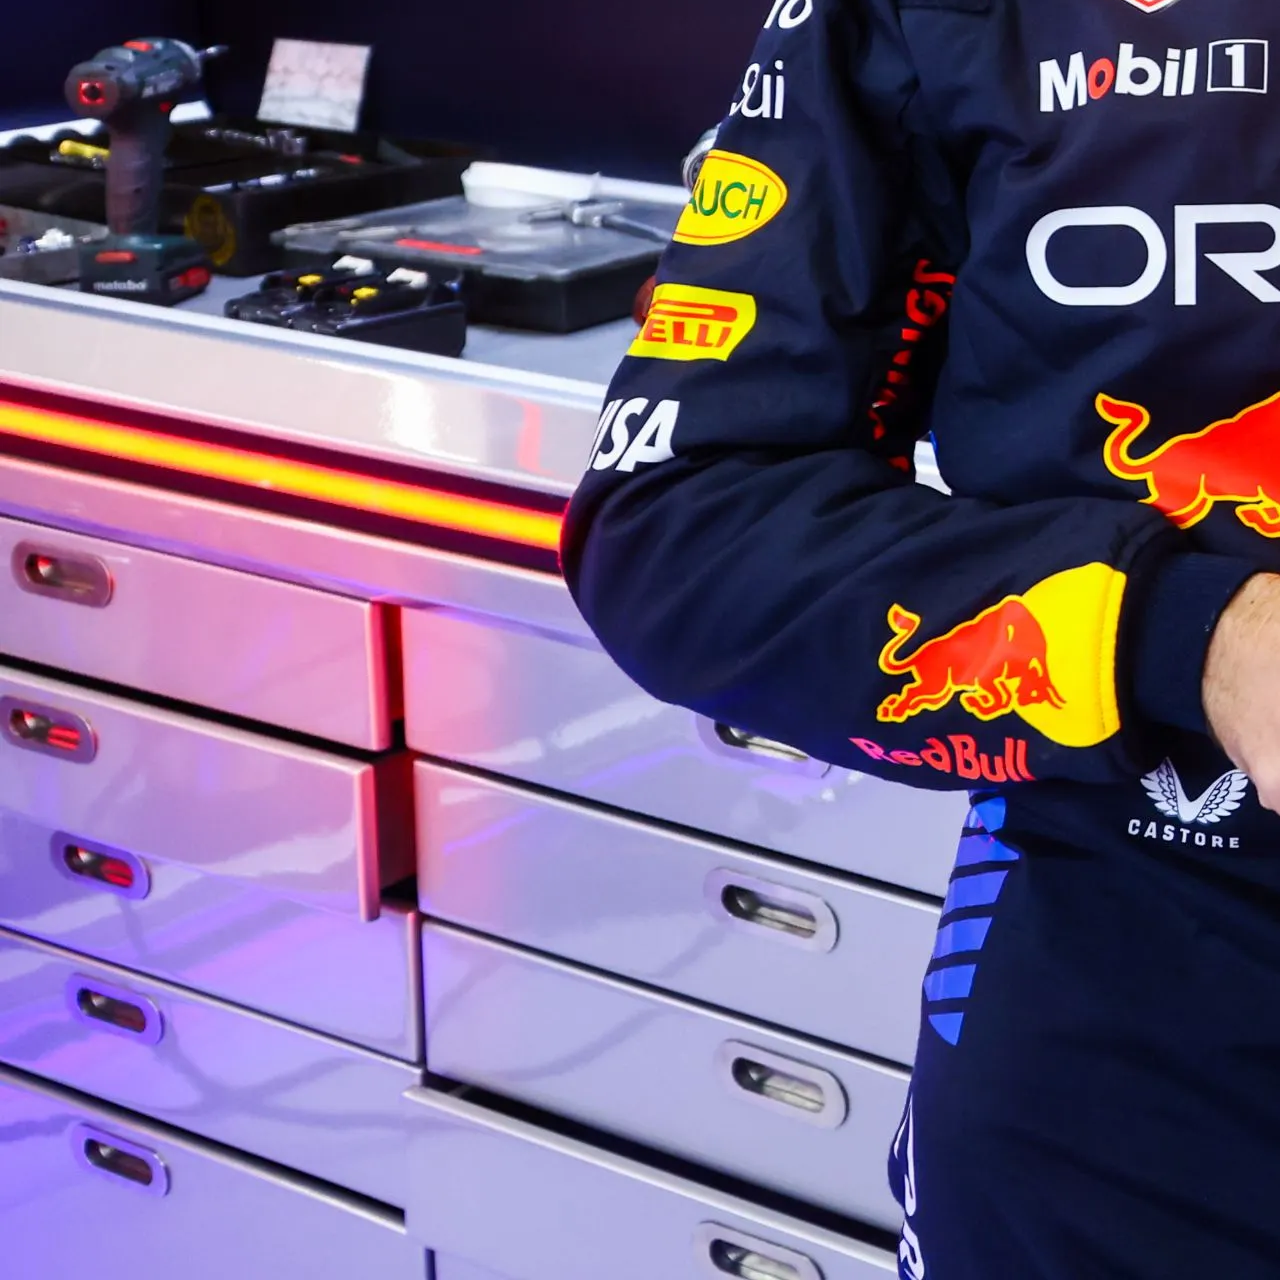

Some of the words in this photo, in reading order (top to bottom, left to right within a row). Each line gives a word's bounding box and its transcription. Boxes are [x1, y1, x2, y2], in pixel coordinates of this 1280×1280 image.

[1039, 42, 1198, 112] Mobil
[848, 737, 952, 774] Red
[946, 733, 1038, 783] Bull
[1127, 818, 1240, 849] CASTORE
